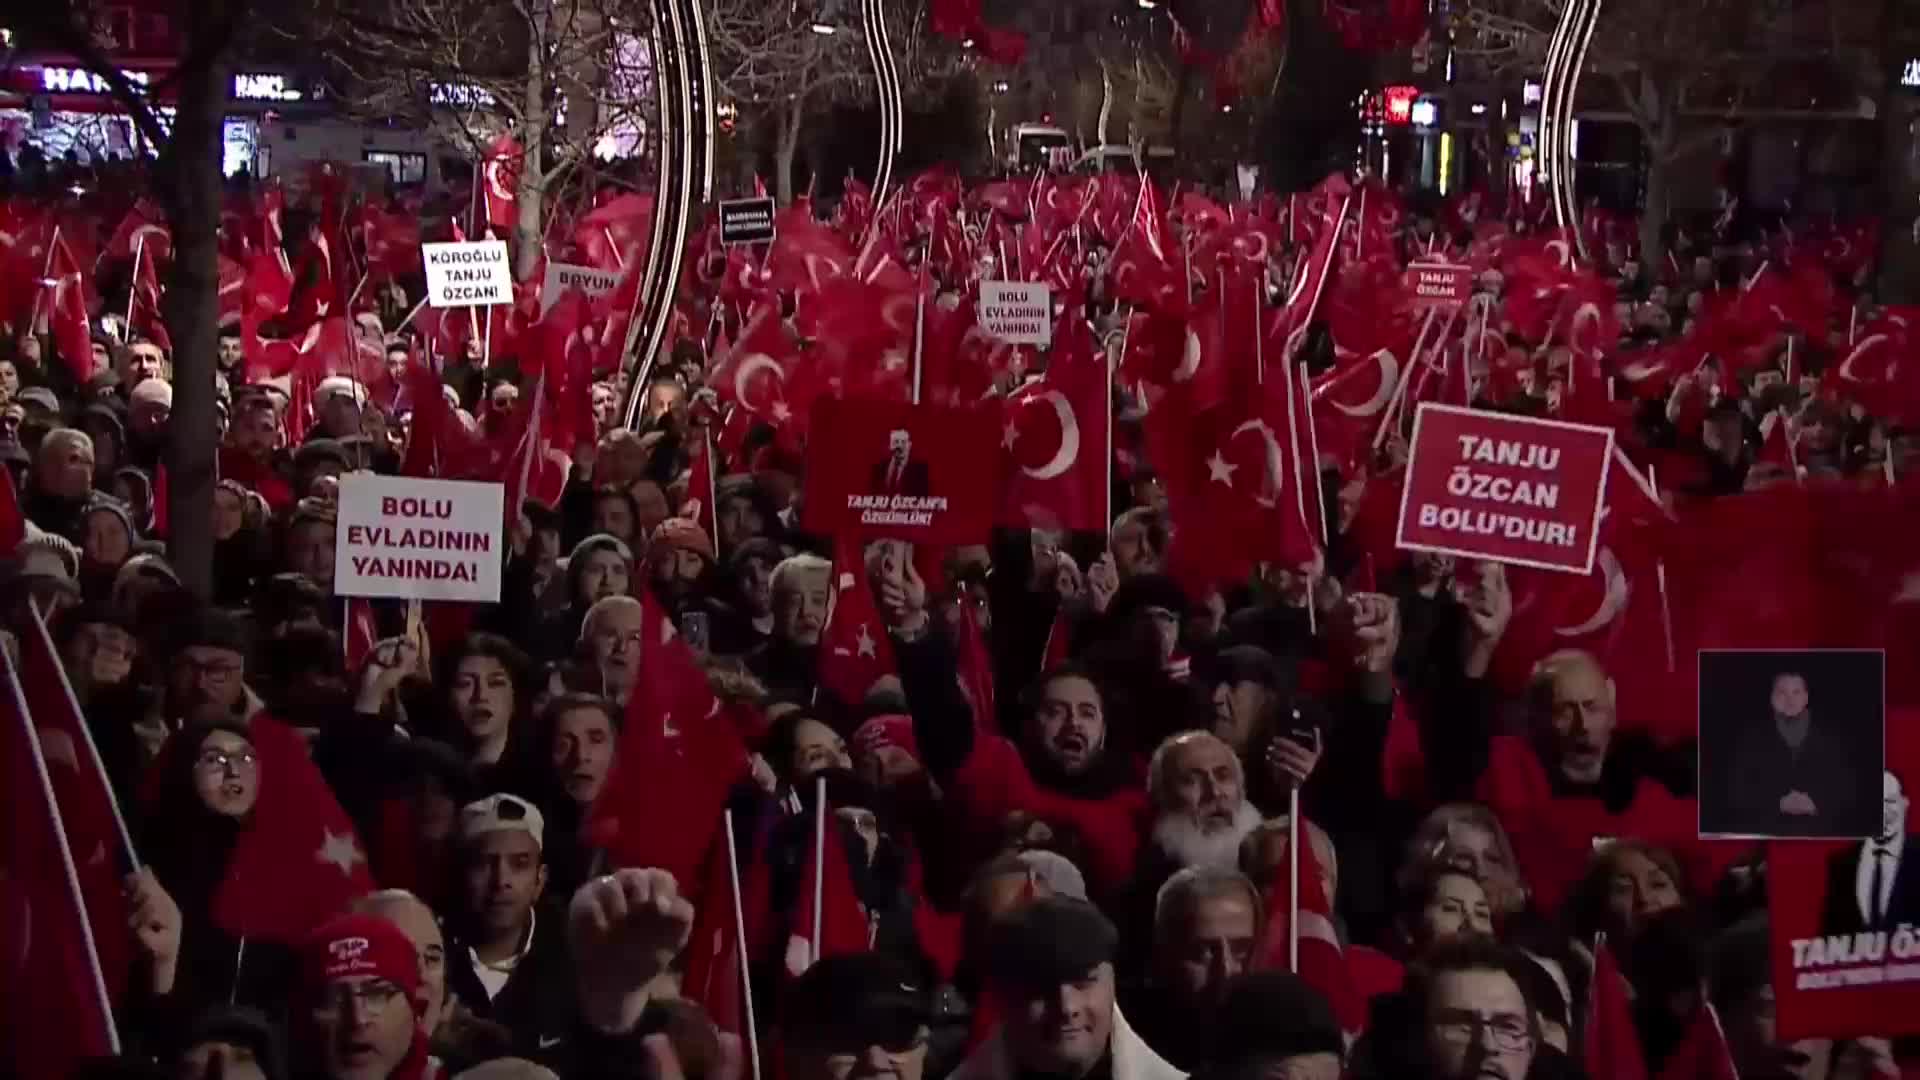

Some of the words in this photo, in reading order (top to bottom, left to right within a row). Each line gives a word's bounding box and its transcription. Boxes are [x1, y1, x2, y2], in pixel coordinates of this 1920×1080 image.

[430, 248, 502, 264] KÖROĞLU
[445, 270, 492, 282] TANJU
[559, 272, 615, 289] BOYUN
[1419, 272, 1454, 284] TANJU
[443, 286, 499, 300] ÖZCAN!
[998, 291, 1028, 302] BOLU
[1416, 283, 1456, 296] ÖZCAN
[986, 307, 1045, 318] EVLADININ
[990, 322, 1041, 334] YANINDA!
[1458, 434, 1561, 471] TANJU
[1447, 464, 1560, 509] ÖZCAN
[382, 496, 453, 519] BOLU
[847, 494, 889, 509] TANJU
[1418, 503, 1577, 547] BOLU'DUR!
[347, 525, 490, 552] EVLADININ
[352, 556, 478, 582] YANINDA!
[1790, 930, 1888, 969] TANJU
